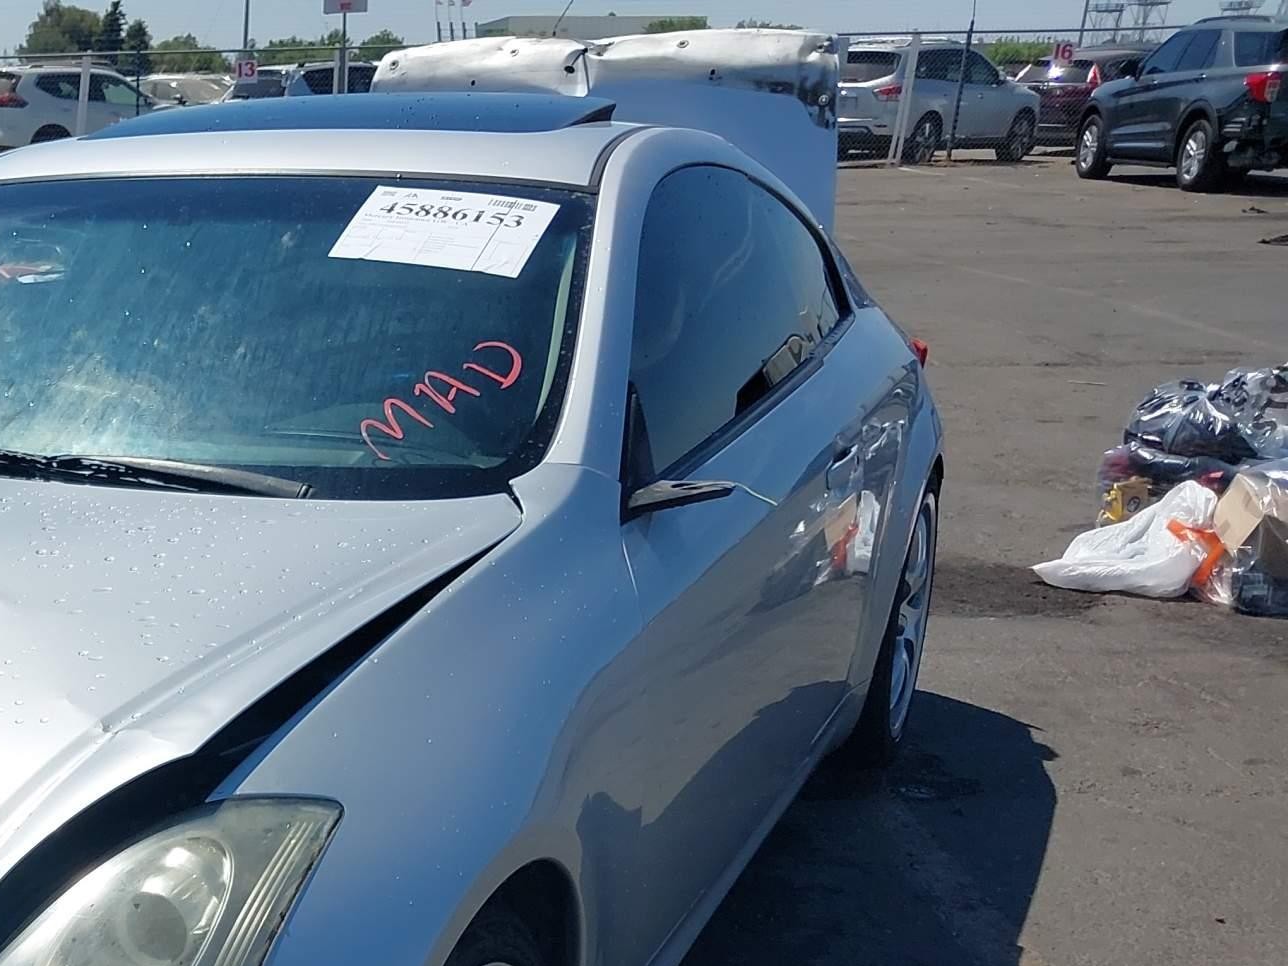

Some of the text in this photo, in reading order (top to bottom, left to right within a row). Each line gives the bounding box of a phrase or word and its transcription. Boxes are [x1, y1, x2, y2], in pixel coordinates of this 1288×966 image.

[1054, 43, 1073, 60] 16
[238, 61, 255, 78] 13
[380, 202, 524, 228] 45886153
[360, 341, 523, 460] MAD
